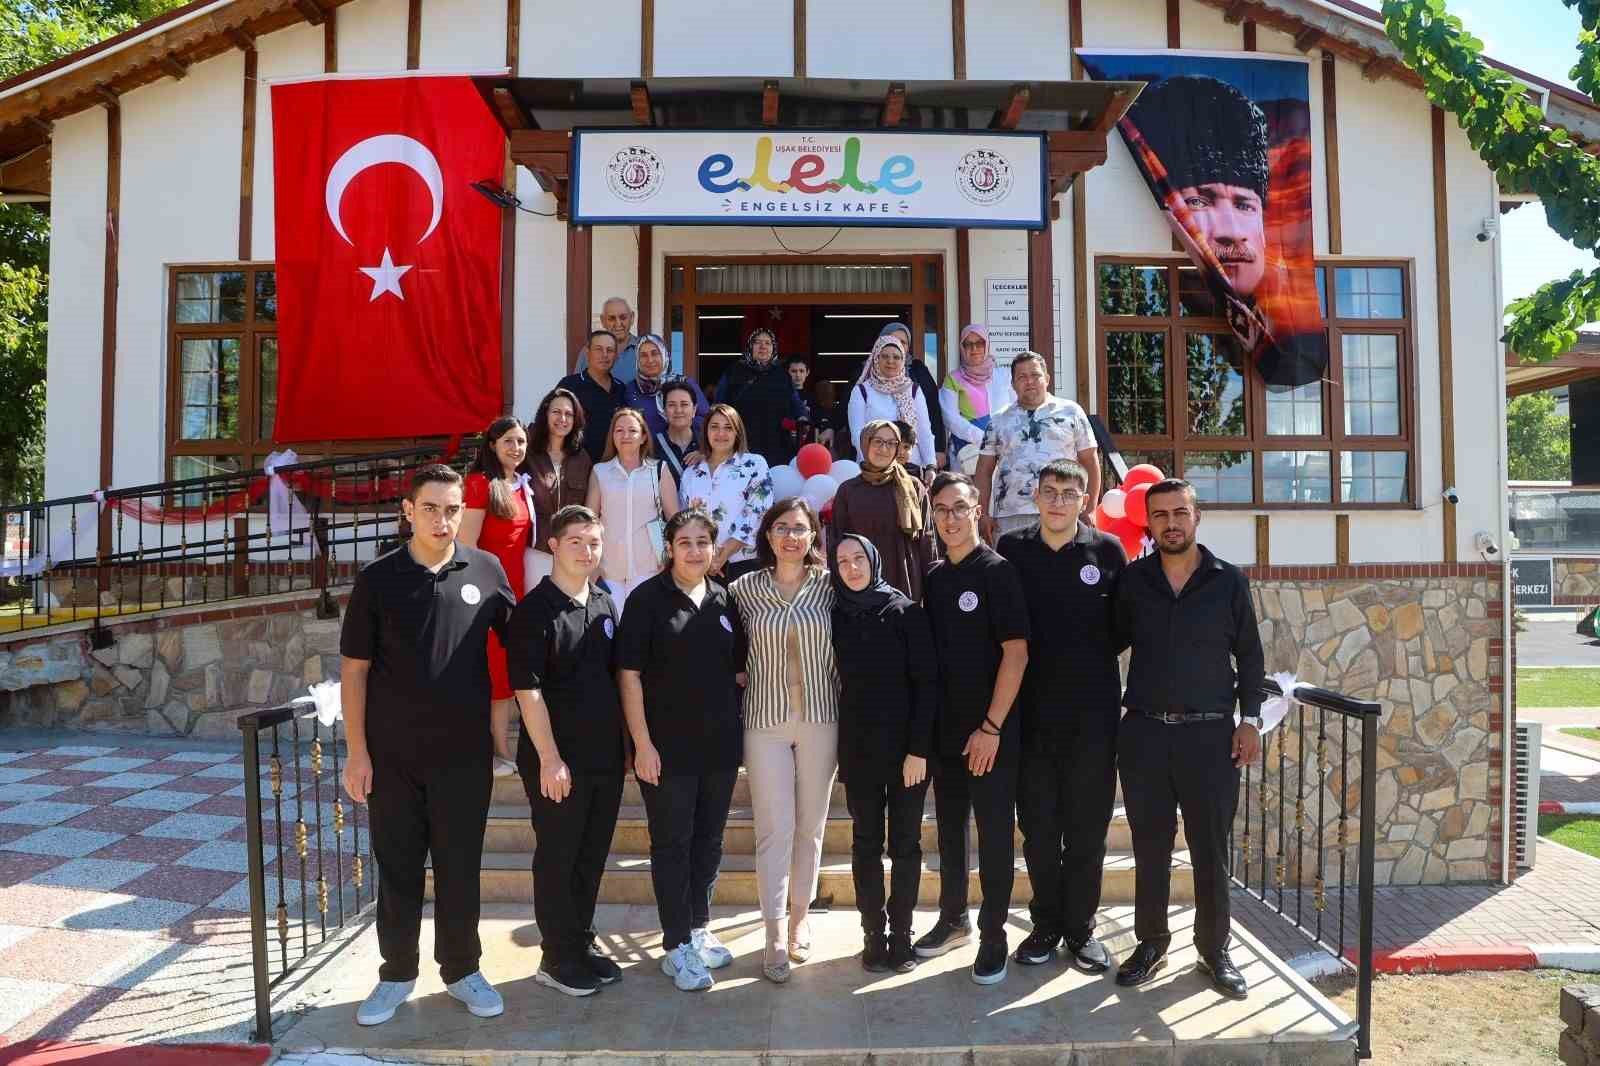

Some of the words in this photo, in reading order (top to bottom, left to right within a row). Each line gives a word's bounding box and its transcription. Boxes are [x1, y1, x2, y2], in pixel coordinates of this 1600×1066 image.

[801, 136, 816, 144] T.C.
[697, 136, 923, 195] elele
[740, 200, 833, 212] ENGELSİZ
[843, 202, 890, 213] KAFE
